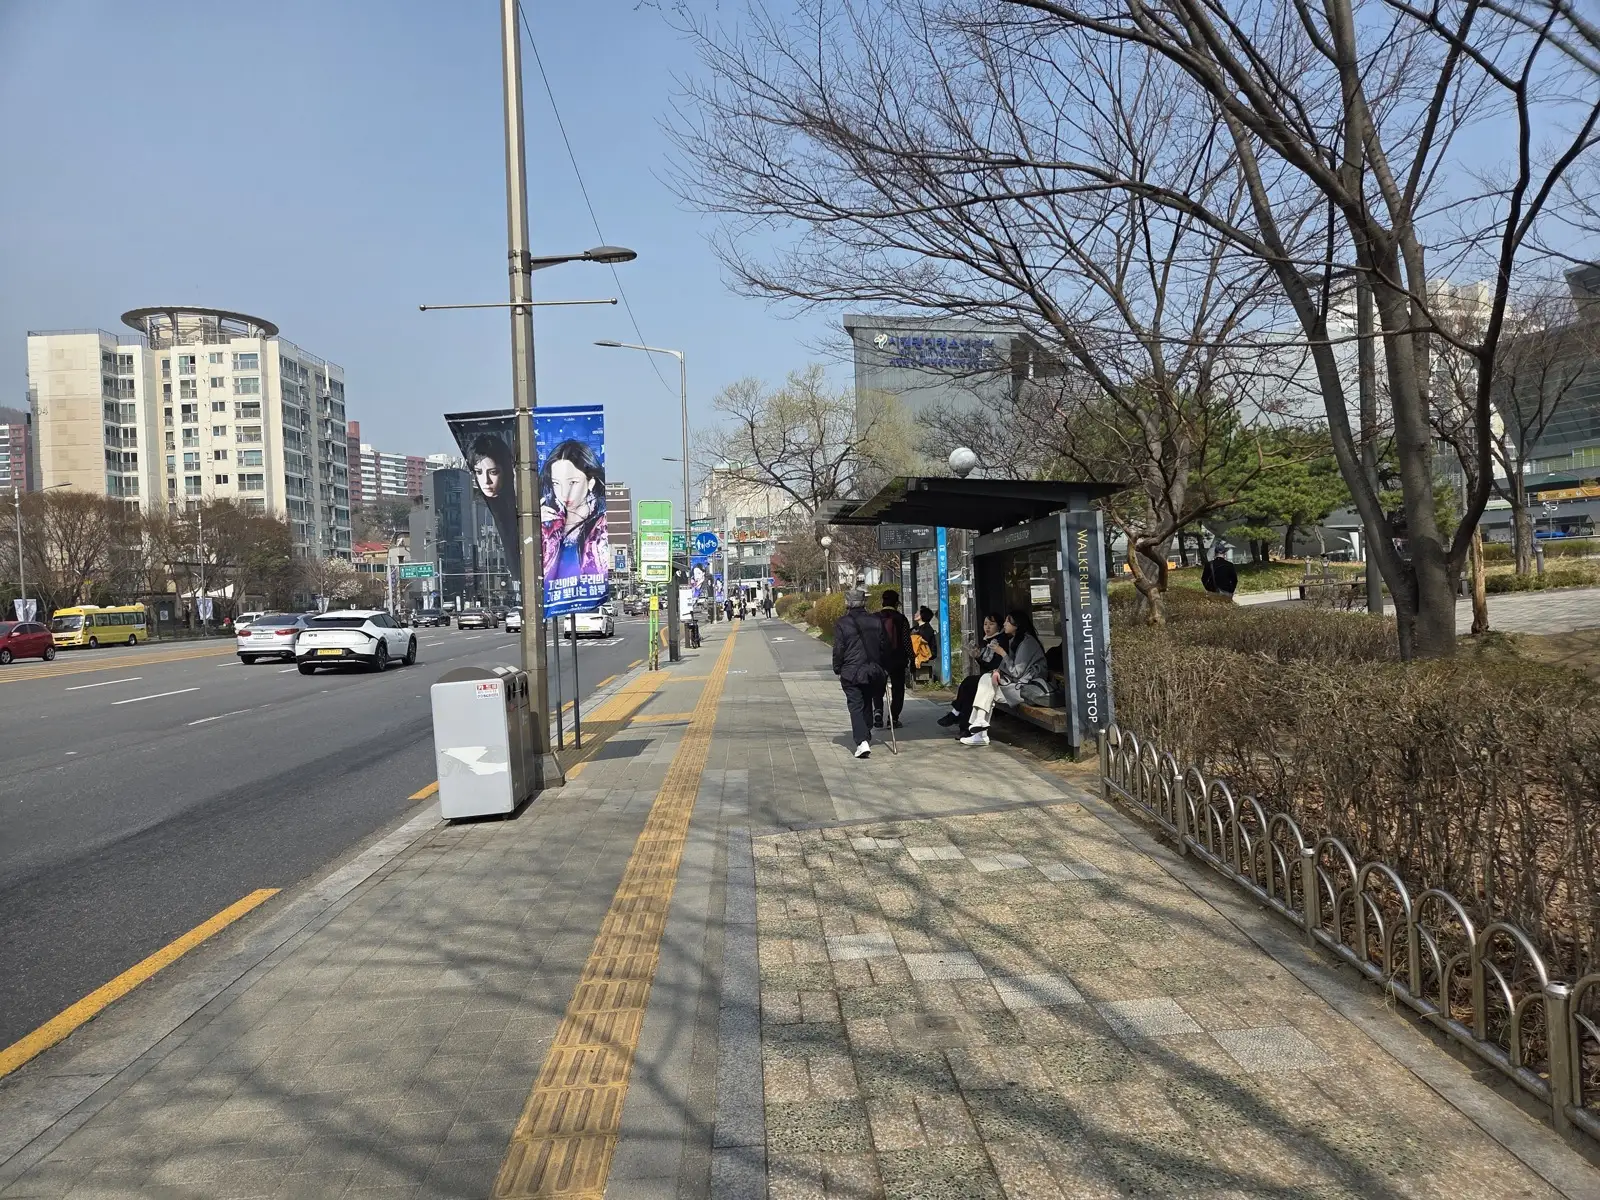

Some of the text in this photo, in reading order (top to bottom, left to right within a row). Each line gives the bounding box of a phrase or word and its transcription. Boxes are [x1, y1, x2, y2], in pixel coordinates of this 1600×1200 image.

[589, 584, 606, 596] 하루
[1077, 529, 1098, 723] WALKERHILL SHUTTLE BUS STOP
